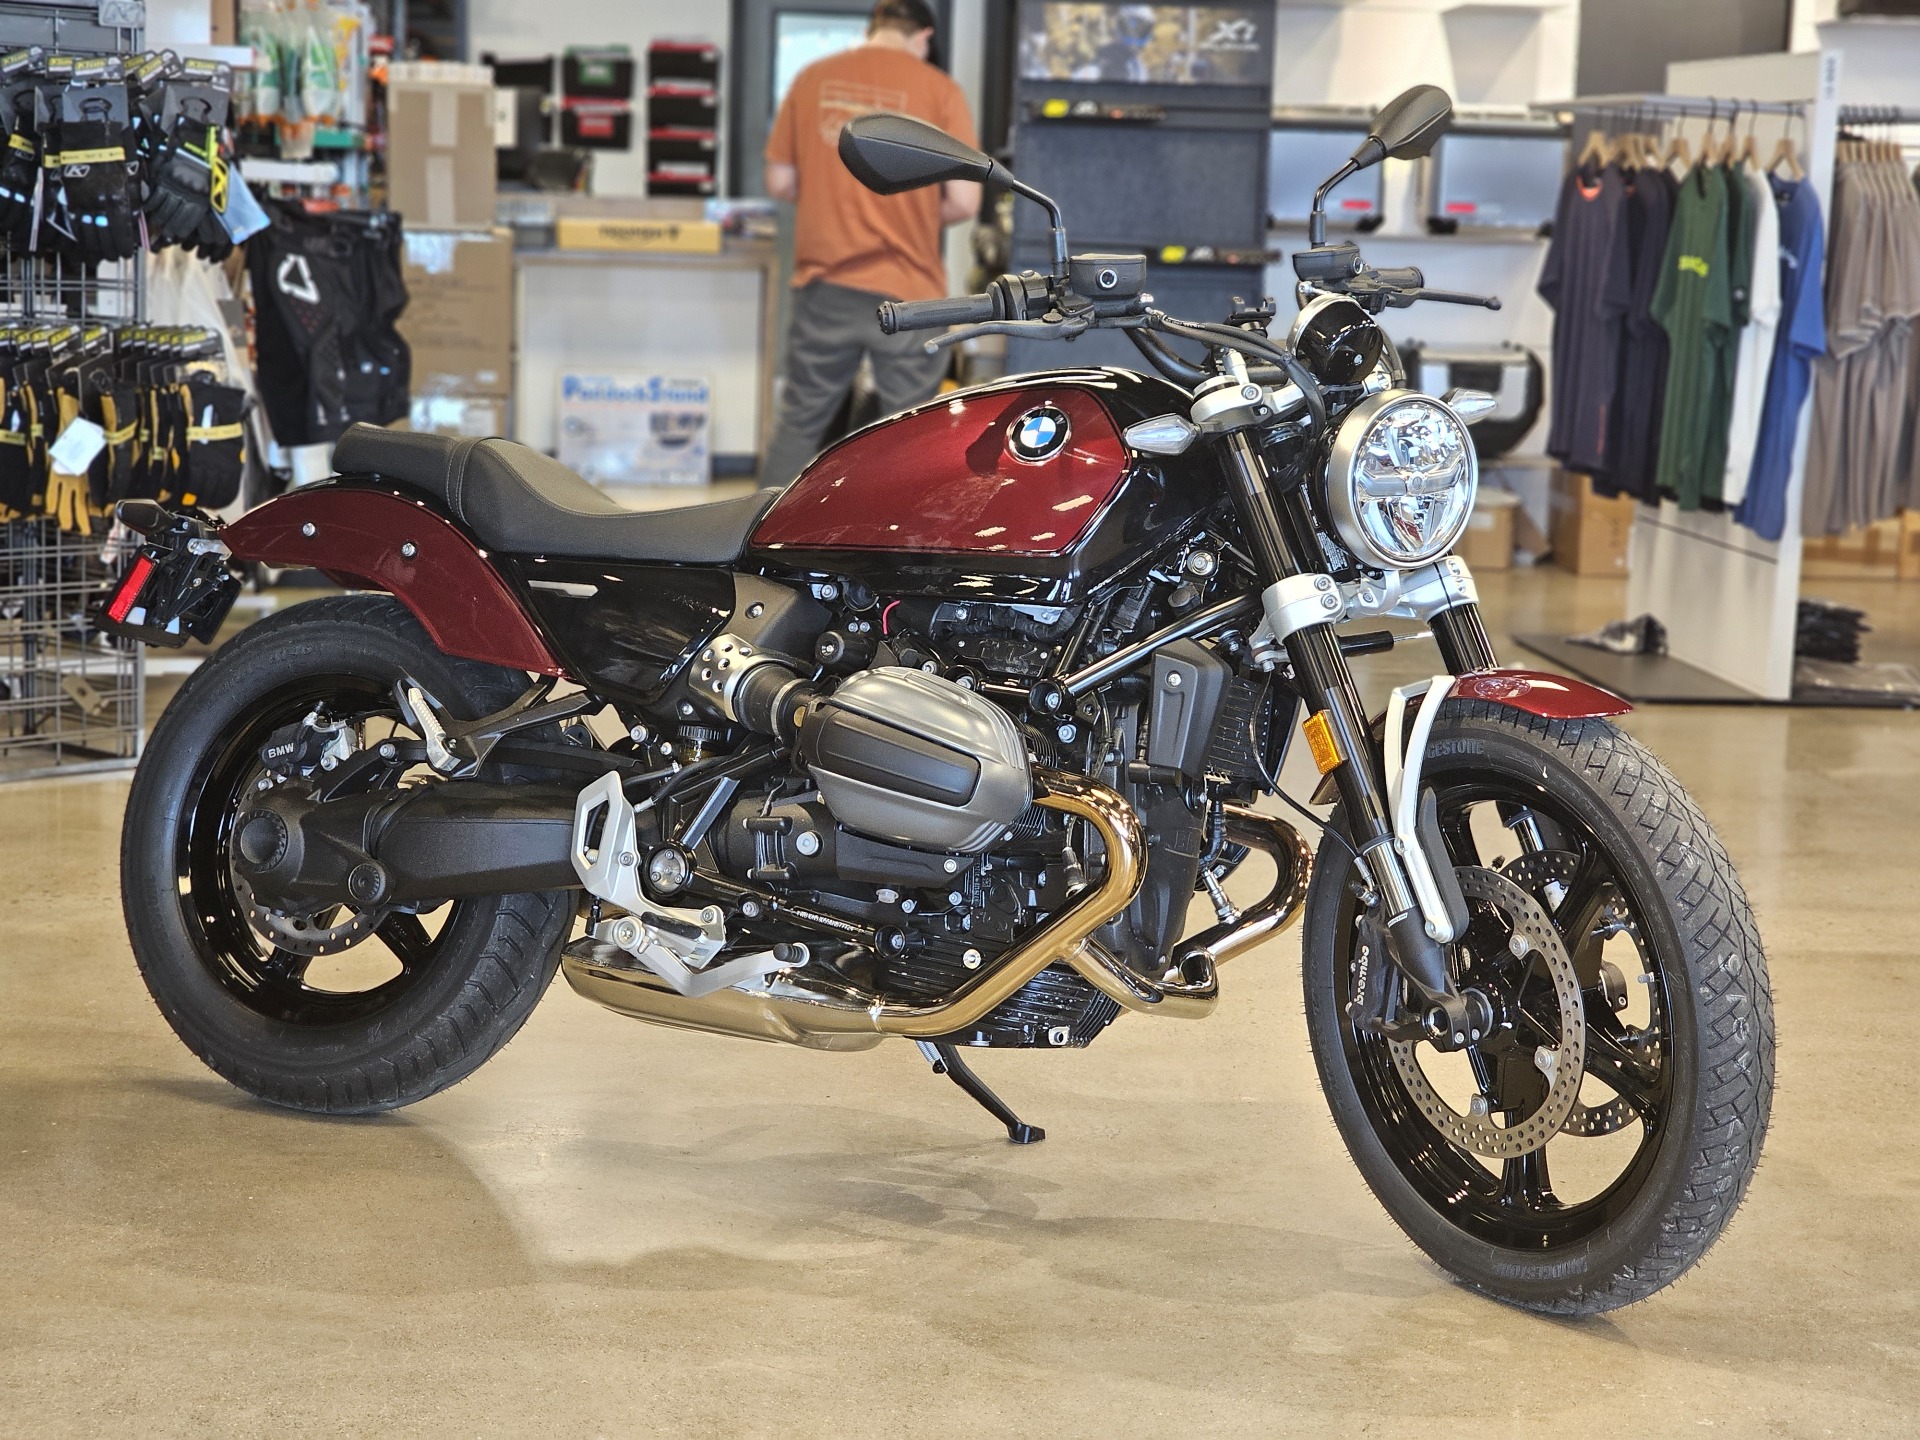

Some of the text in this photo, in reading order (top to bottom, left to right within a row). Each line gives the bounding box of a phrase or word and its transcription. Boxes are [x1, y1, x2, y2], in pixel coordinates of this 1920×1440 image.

[268, 742, 294, 758] BMW
[1426, 738, 1485, 758] GESTONE
[1354, 945, 1370, 1006] brembo
